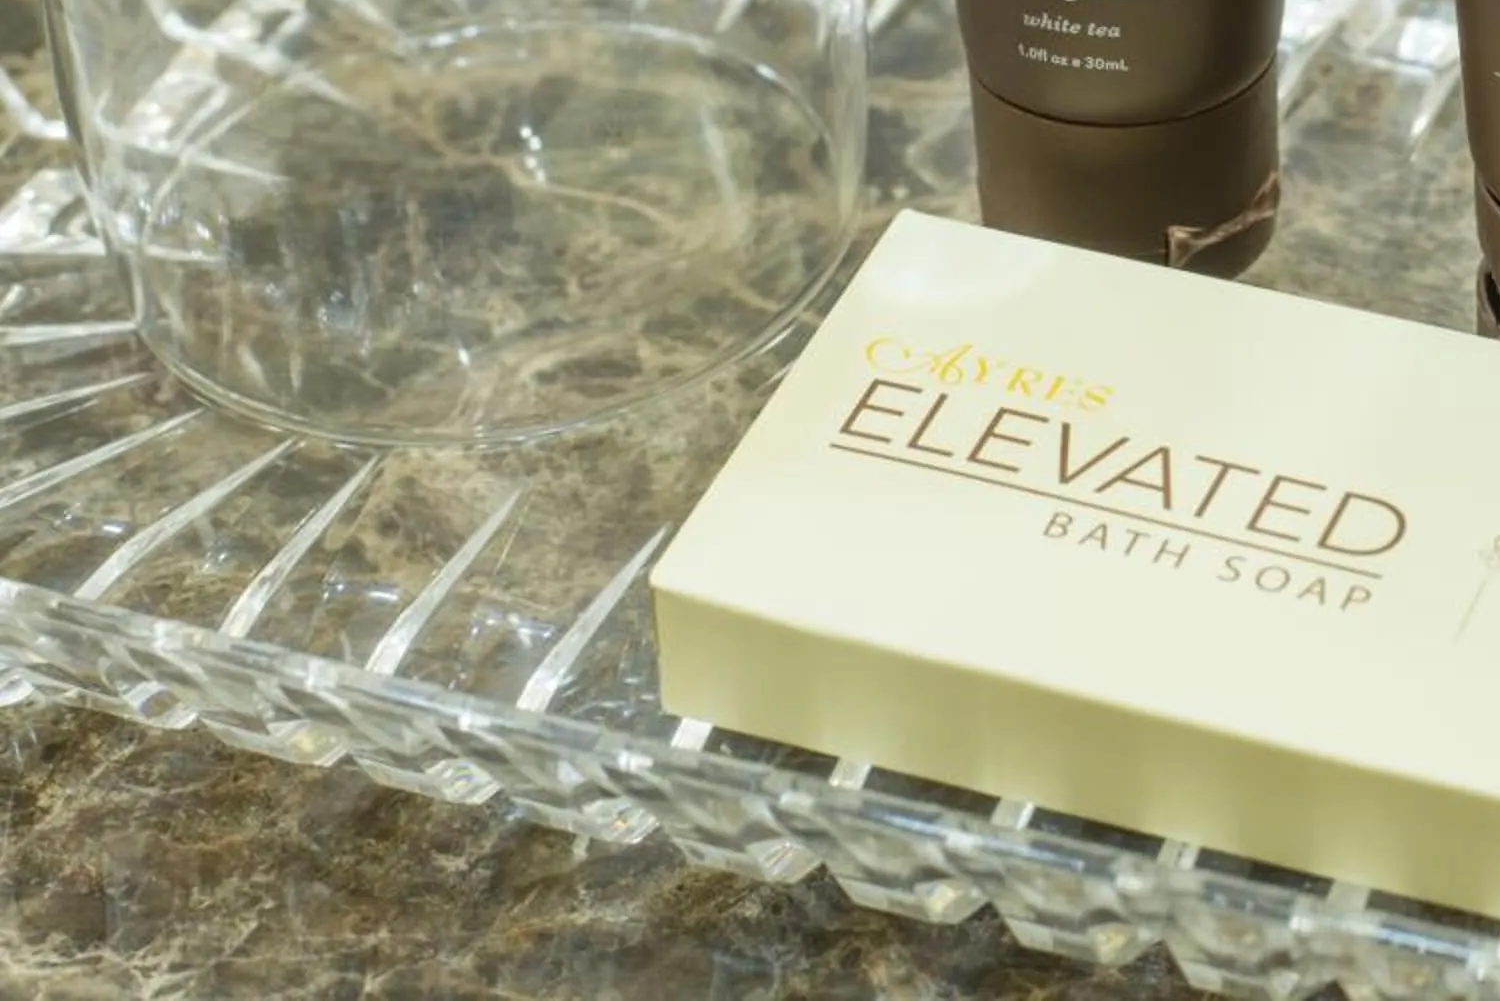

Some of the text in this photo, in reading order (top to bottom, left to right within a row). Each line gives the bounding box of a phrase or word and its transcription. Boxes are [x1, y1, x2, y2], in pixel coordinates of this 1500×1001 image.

[1023, 12, 1121, 38] white tea
[1050, 54, 1069, 66] oz
[1085, 56, 1129, 72] 30mL
[864, 336, 1115, 410] AYRES
[839, 377, 1407, 557] ELEVATED
[1042, 511, 1374, 612] BATH SOAP
